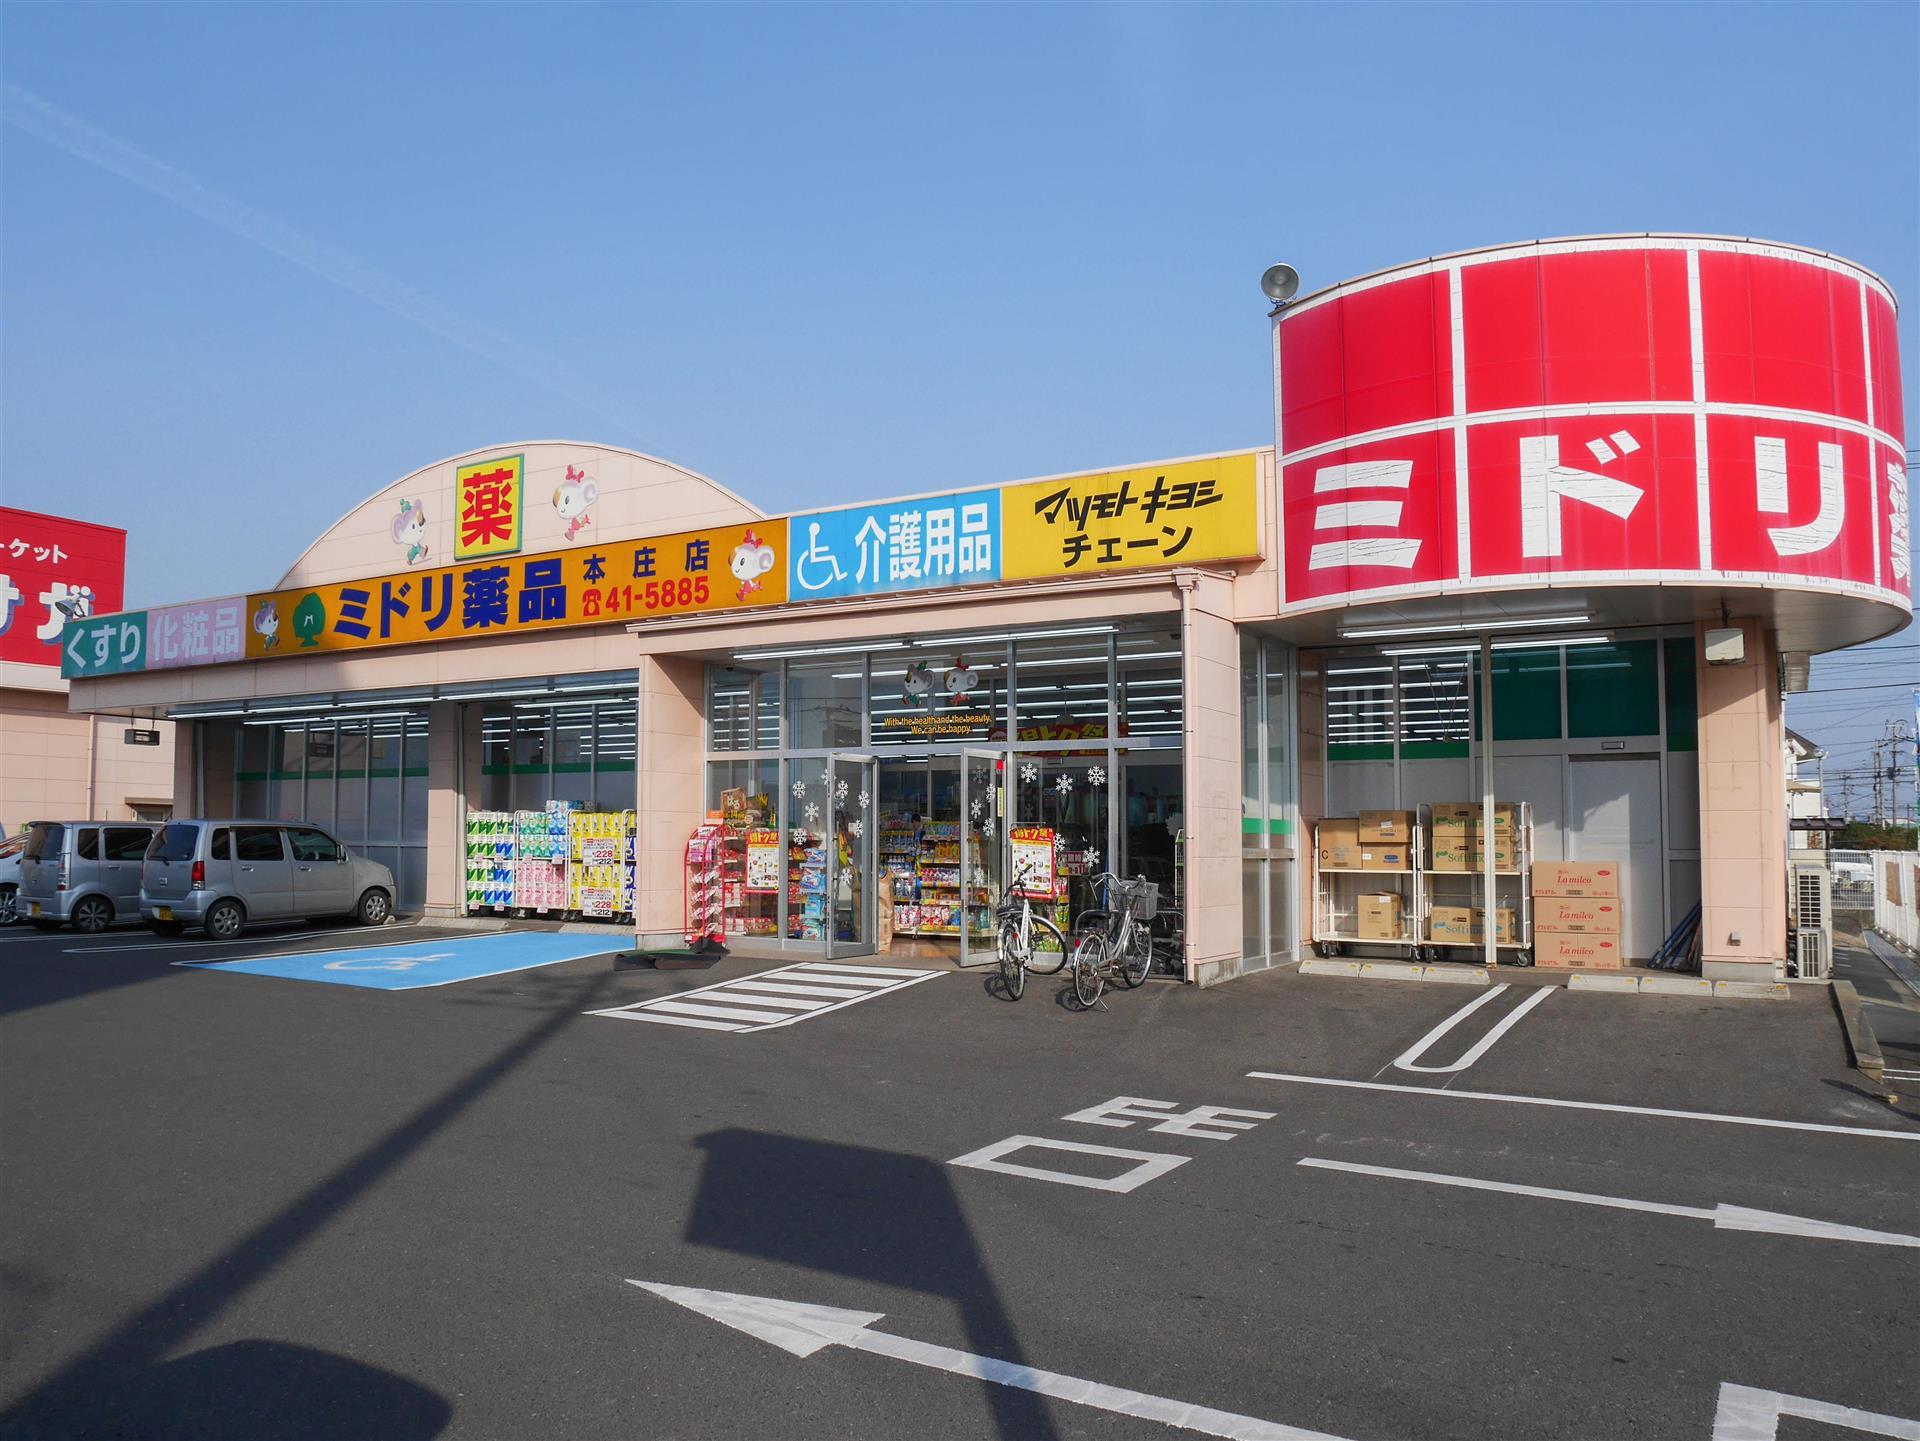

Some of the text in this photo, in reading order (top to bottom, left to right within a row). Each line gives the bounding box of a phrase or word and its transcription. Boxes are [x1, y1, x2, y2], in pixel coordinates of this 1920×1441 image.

[461, 468, 514, 547] 薬
[1034, 476, 1223, 531] マツモトキヨシ
[1308, 430, 1845, 570] ミドリ
[0, 538, 68, 564] ケット
[582, 538, 710, 585] 本庄店
[854, 503, 991, 584] 介護用品
[1062, 526, 1193, 568] チェーン
[333, 557, 566, 639] ミドリ薬品
[605, 575, 710, 613] 41-5885
[67, 621, 142, 668] くすり
[152, 606, 240, 664] 化粧品
[884, 718, 899, 726] With
[901, 717, 912, 726] the
[914, 715, 936, 725] health
[937, 715, 950, 724] and
[952, 714, 963, 723] the
[911, 726, 922, 734] We
[924, 726, 935, 734] can
[936, 725, 947, 733] be
[945, 1096, 1279, 1194] 出口
